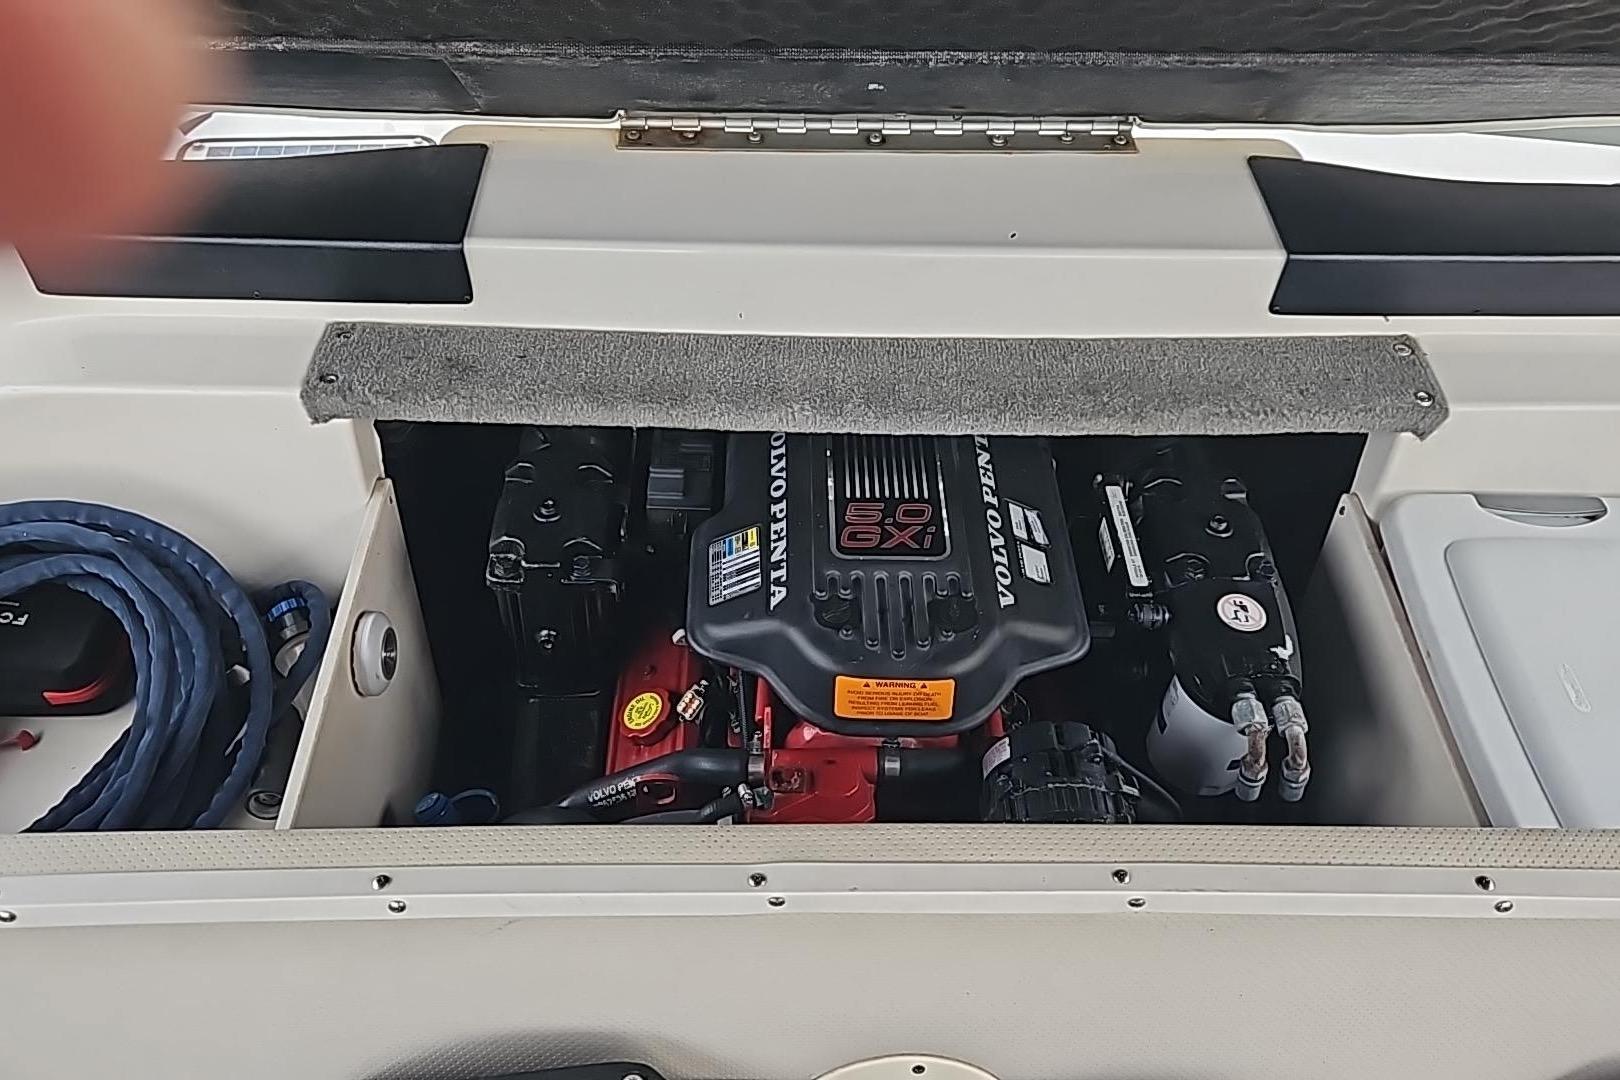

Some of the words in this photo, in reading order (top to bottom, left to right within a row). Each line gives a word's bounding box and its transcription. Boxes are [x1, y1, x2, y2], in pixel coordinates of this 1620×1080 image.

[770, 432, 787, 498] OLVO
[974, 434, 999, 508] PENT
[841, 526, 936, 548] GXi
[845, 503, 932, 523] 5.0
[770, 499, 787, 611] PENTA
[986, 508, 1016, 609] VOLVO
[587, 785, 616, 802] VOLVO
